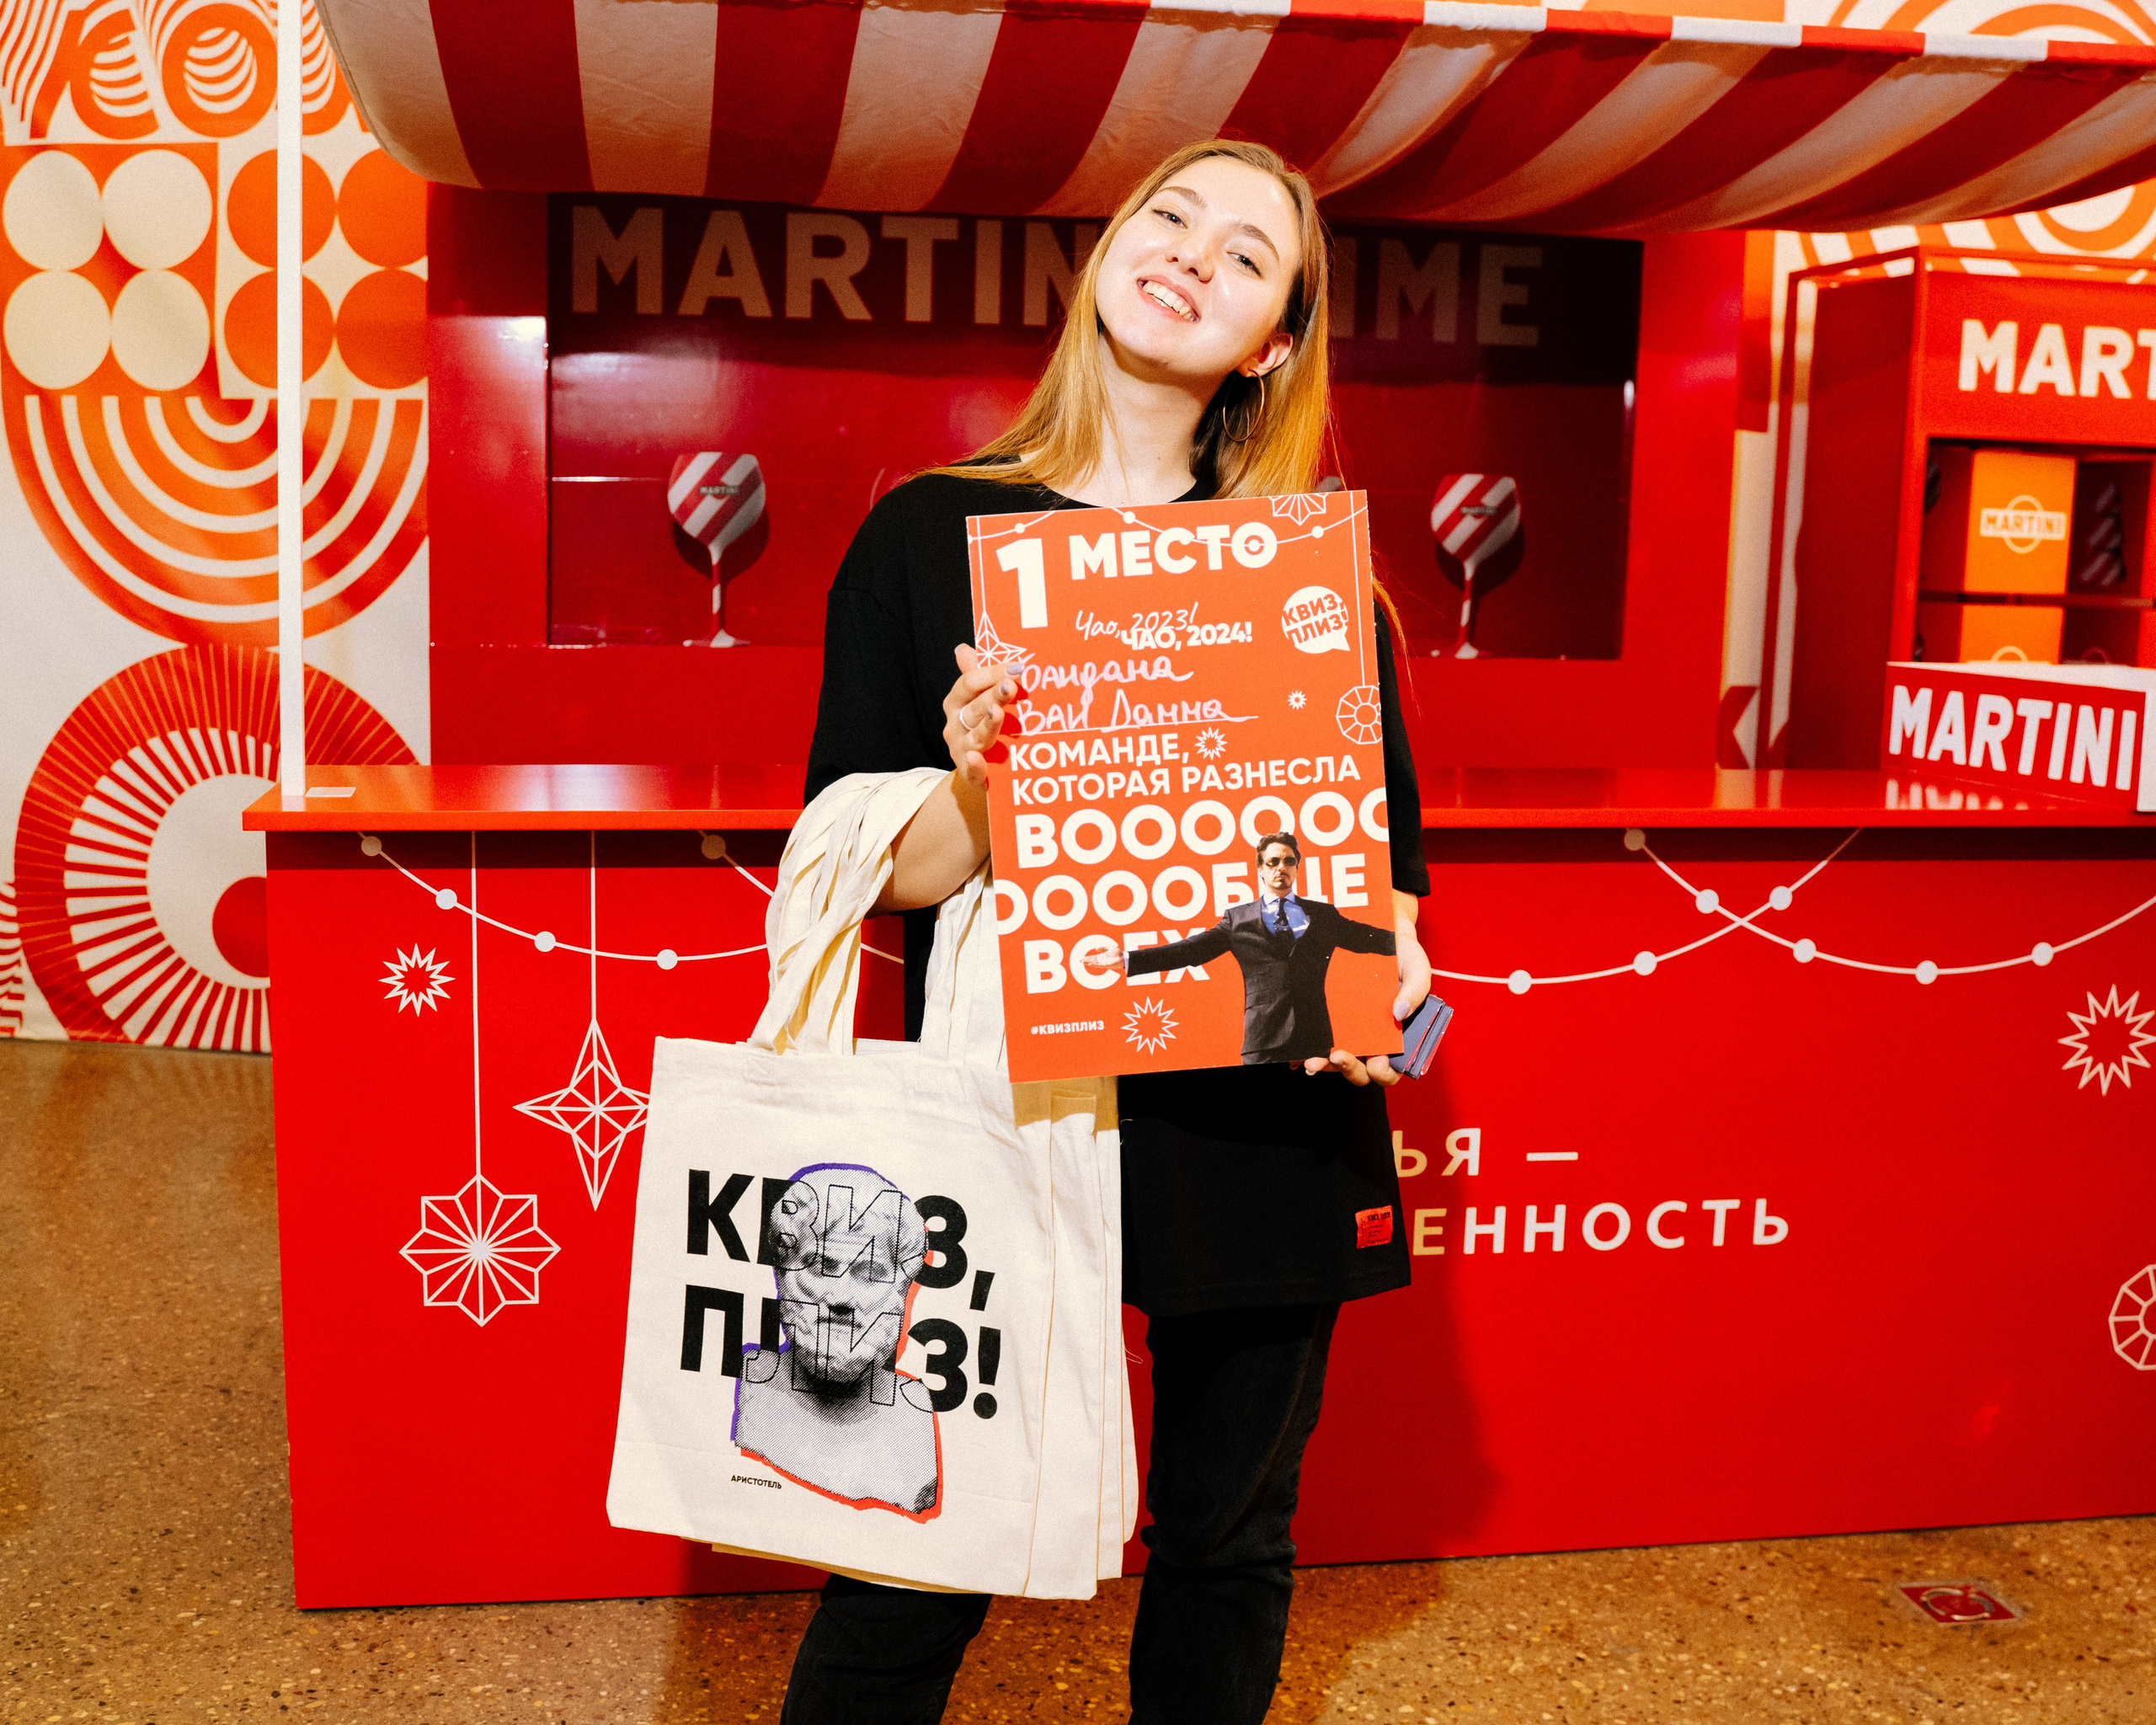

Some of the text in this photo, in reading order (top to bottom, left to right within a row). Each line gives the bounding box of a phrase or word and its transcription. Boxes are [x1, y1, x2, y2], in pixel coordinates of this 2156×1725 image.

[1984, 513, 2064, 536] MARTINI
[996, 521, 1278, 629] 1 МЕСТО
[1075, 601, 1198, 640] Чао, 2023!
[1282, 594, 1345, 627] КВИЗ,
[1286, 611, 1349, 644] ПЛИЗ!
[1121, 622, 1253, 650] ЧАО, 2024!
[1010, 733, 1189, 772] КОМАНДЕ,
[1889, 685, 2137, 791] MARTINI
[1011, 755, 1361, 806] КОТОРАЯ РАЗНЕСЛА
[1031, 1020, 1105, 1035] #КВИЗПЛИЗ
[686, 1168, 995, 1311] КВИЗ,
[680, 1284, 1001, 1420] ПЛИЗ!
[731, 1475, 782, 1489] АРИСТОТЕЛЬ
